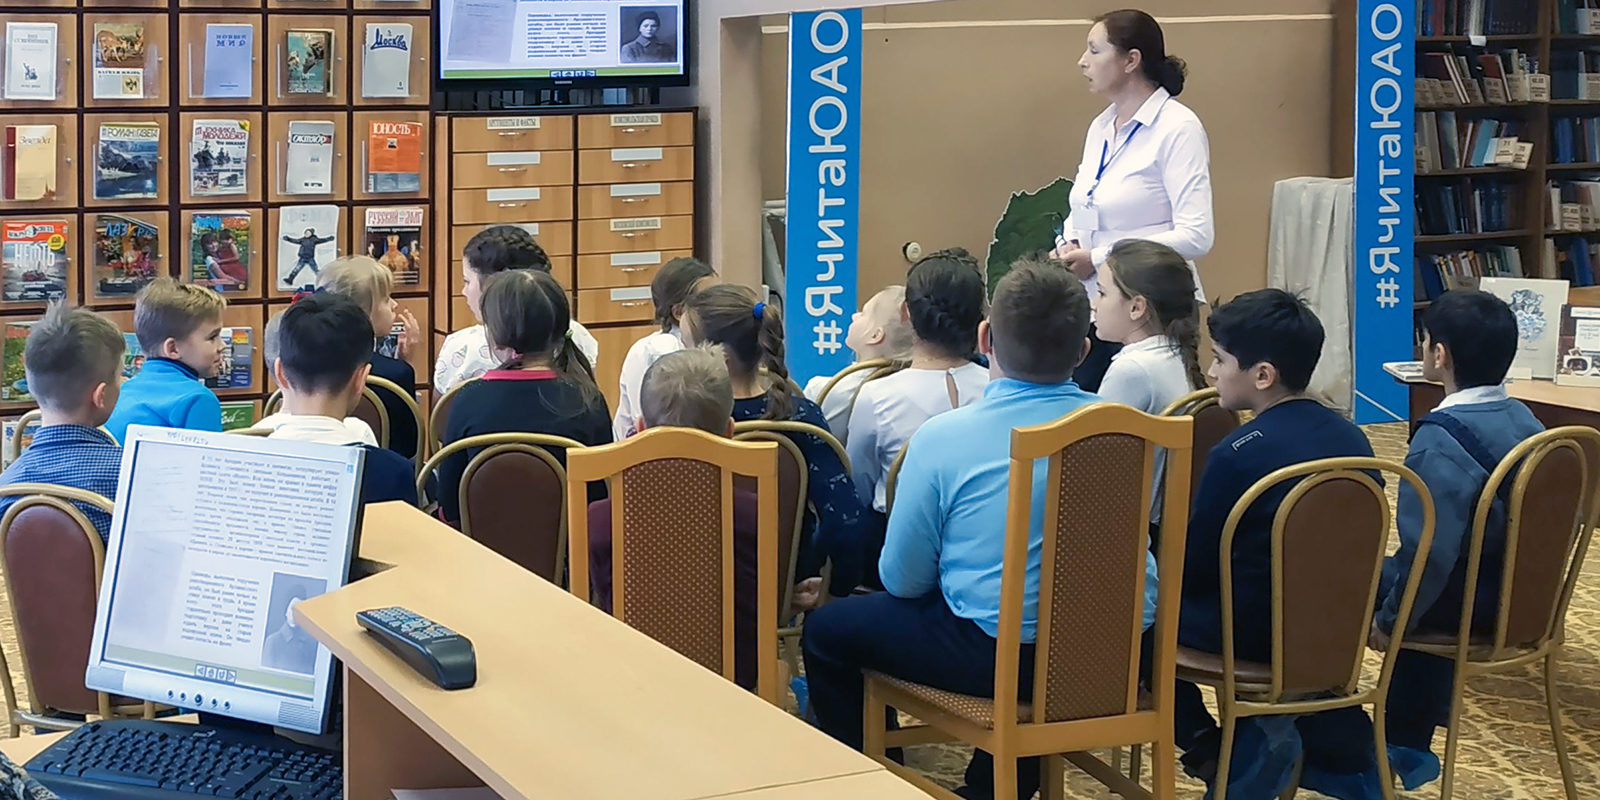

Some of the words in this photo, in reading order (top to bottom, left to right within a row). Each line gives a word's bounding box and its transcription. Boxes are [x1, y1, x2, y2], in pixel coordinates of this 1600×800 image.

[373, 122, 411, 135] ЮНОСТЬ
[805, 11, 850, 355] #ЯчитаЮАО
[1369, 3, 1403, 309] #ЯчитаЮАО
[14, 243, 56, 269] НЕФТЬ
